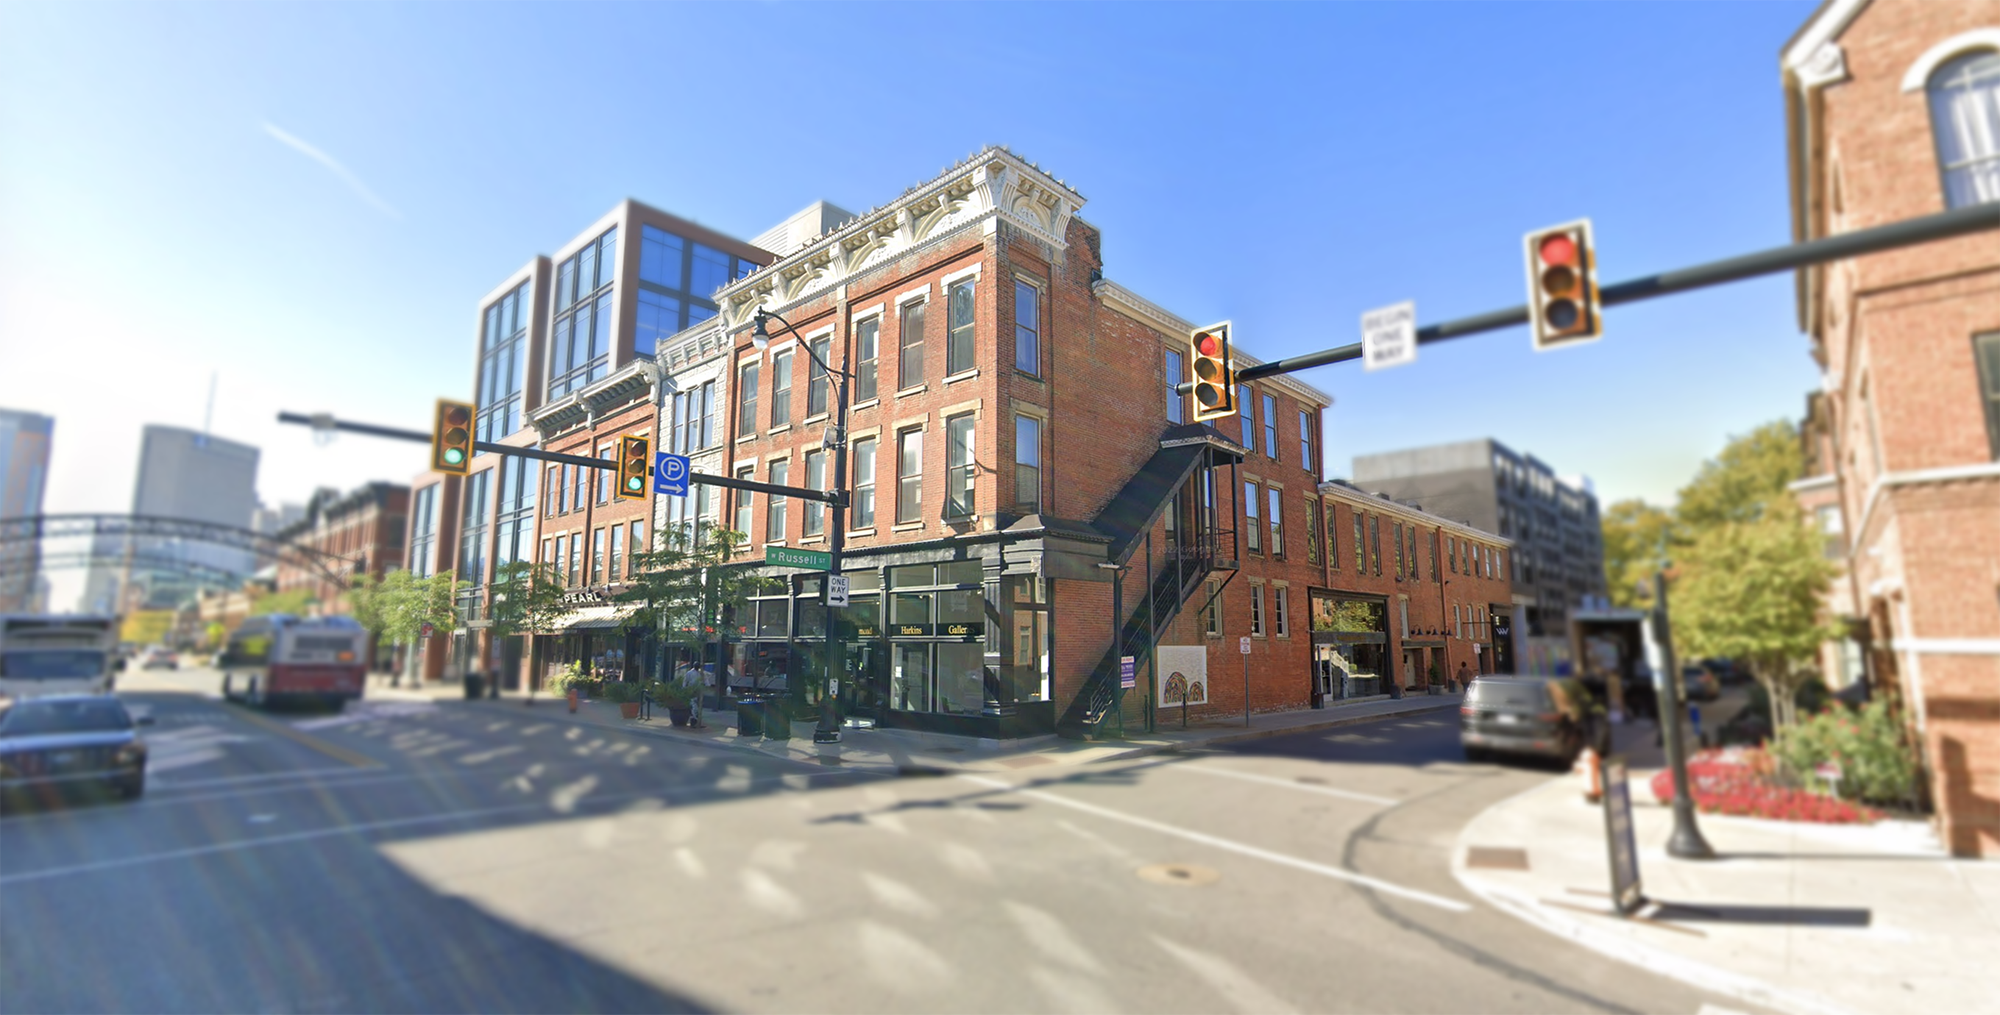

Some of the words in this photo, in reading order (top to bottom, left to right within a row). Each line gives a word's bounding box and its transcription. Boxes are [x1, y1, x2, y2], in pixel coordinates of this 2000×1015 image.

[1373, 327, 1402, 345] ONE
[1373, 345, 1404, 362] WAY
[667, 461, 680, 476] P
[778, 551, 817, 565] Russell
[831, 577, 846, 586] ONE
[831, 586, 846, 594] WAY
[564, 592, 601, 603] PEARL
[901, 626, 922, 635] Harkins
